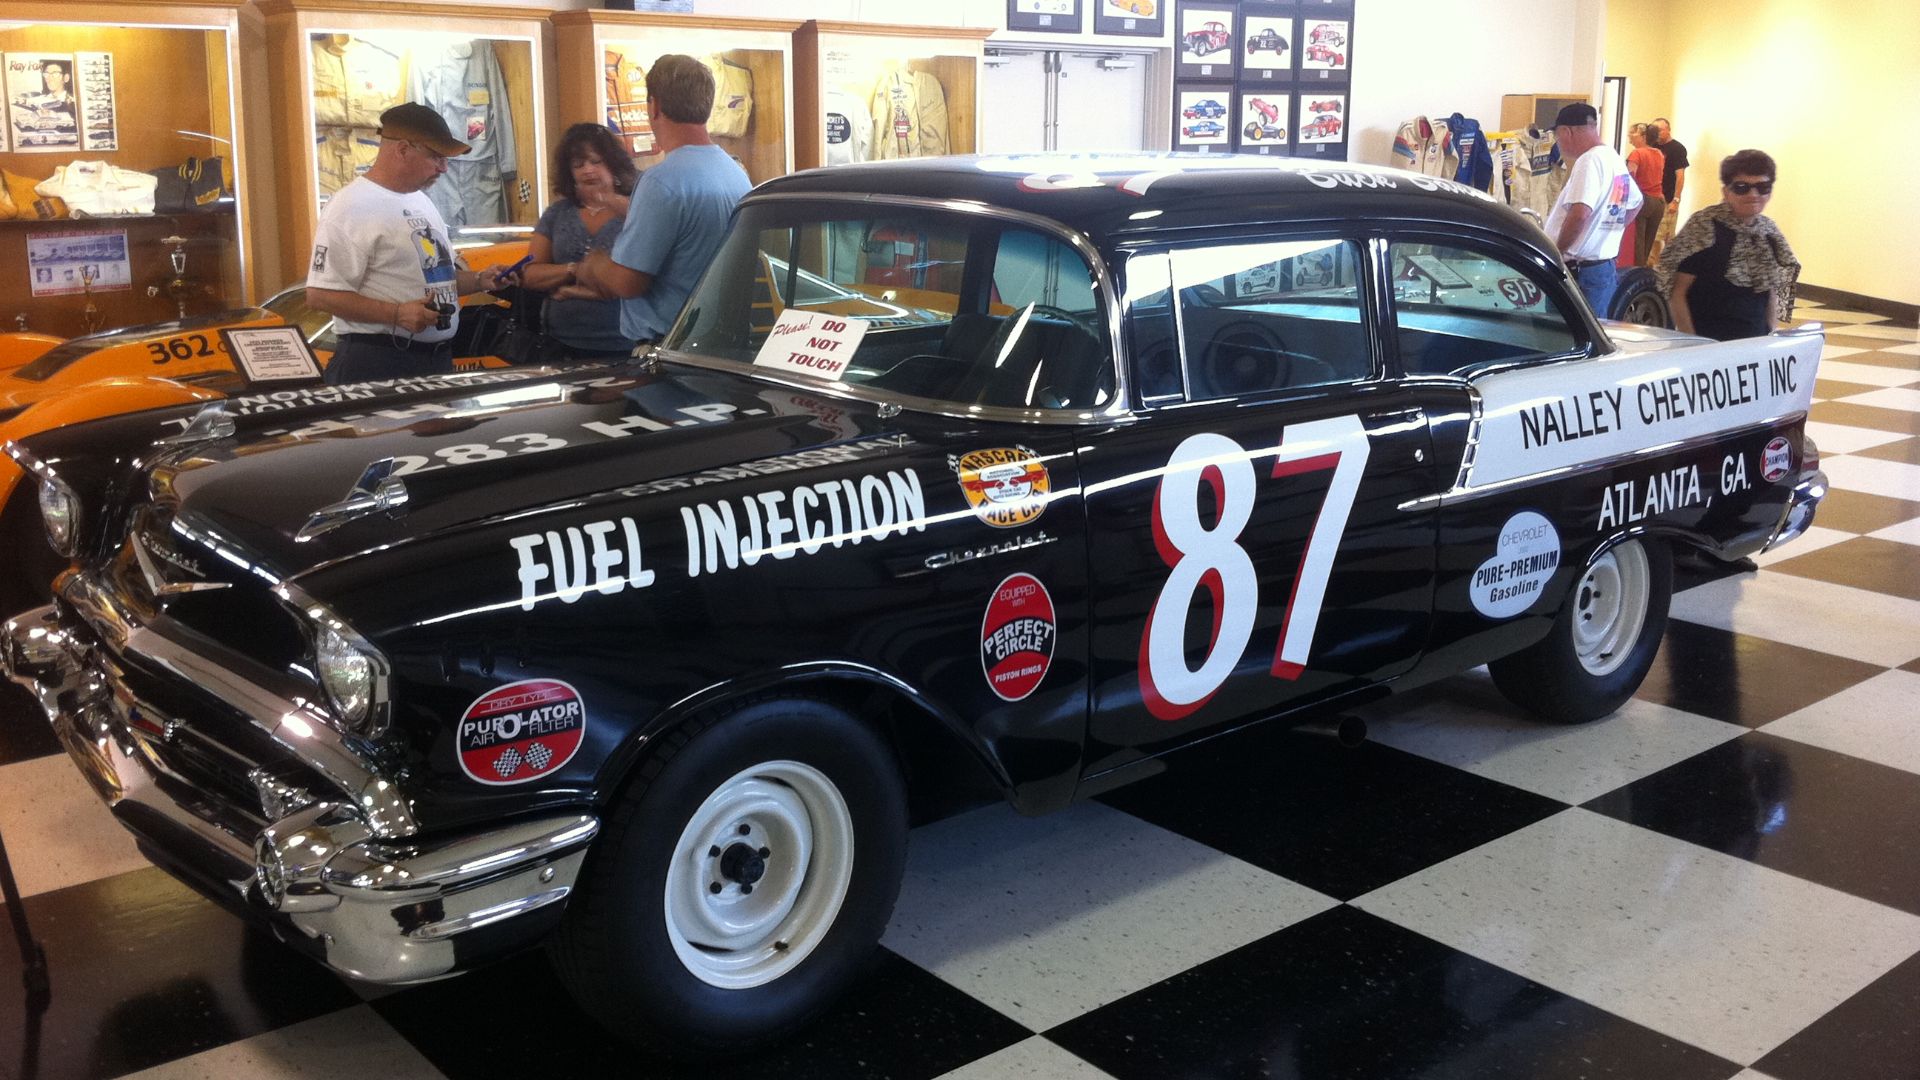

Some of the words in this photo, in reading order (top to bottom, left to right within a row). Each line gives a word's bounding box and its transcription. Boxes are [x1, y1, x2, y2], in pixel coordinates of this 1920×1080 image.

[1503, 278, 1537, 303] STP
[772, 315, 814, 338] Please!
[821, 320, 847, 333] DO
[147, 334, 215, 366] 362
[806, 337, 842, 352] NOT
[787, 352, 843, 372] TOUCH
[1519, 387, 1623, 450] NALLEY
[1637, 362, 1760, 426] CHEVROLET
[1768, 354, 1798, 397] INC
[394, 432, 569, 477] 283
[580, 402, 768, 438] H.P.
[1720, 452, 1752, 496] GA.
[509, 517, 655, 611] FUEL
[680, 468, 926, 578] INJECTION
[925, 531, 1059, 569] Chevrolet
[1501, 524, 1548, 547] CHEVROLET
[1138, 414, 1371, 721] 87
[1476, 549, 1558, 588] PURE-PREMIUM
[1000, 584, 1036, 601] EQUIPPED
[1011, 598, 1026, 607] WITH
[1489, 579, 1539, 603] Gasoline
[984, 619, 1053, 655] PERFECT
[995, 635, 1043, 661] CIRCLE
[995, 669, 1020, 683] PISTON
[1020, 663, 1042, 677] RINGS
[490, 697, 516, 711] DRY
[464, 701, 579, 739] PUROLATOR
[470, 732, 495, 747] AIR
[529, 715, 574, 736] FILTER
